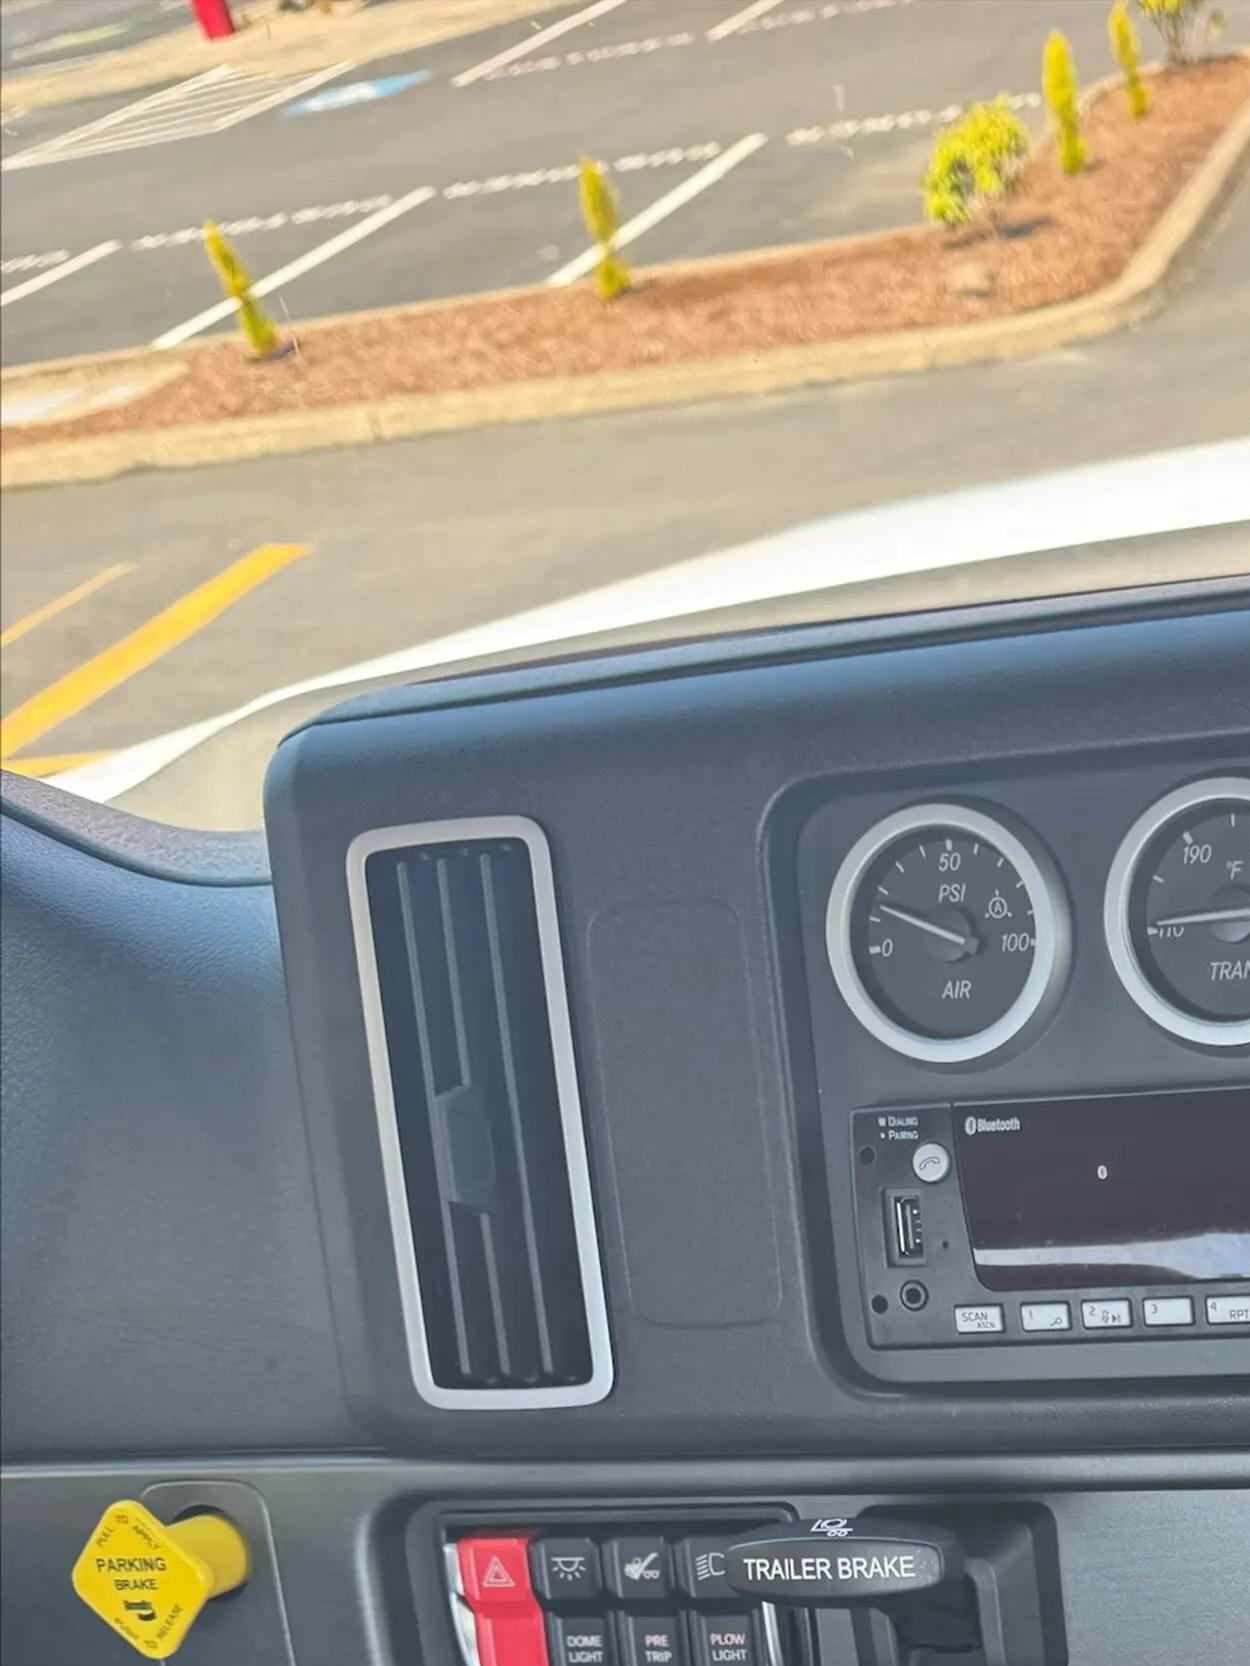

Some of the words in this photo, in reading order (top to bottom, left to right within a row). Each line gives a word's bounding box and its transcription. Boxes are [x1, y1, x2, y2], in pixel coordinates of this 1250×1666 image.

[1183, 845, 1212, 865] 190
[938, 854, 961, 871] 50
[938, 883, 966, 902] PSI
[881, 939, 893, 957] 0
[1001, 933, 1029, 951] 100
[942, 980, 972, 999] AIR
[977, 1117, 1020, 1132] Bluetooth
[961, 1311, 988, 1323] SCAN
[1229, 1308, 1249, 1320] RPT
[95, 1557, 167, 1573] PARKING
[744, 1557, 832, 1581] TRAILER
[838, 1555, 915, 1579] BRAKE
[114, 1578, 158, 1591] BRAKE
[567, 1635, 602, 1648] DOME
[645, 1634, 669, 1648] PRE
[710, 1633, 745, 1646] PLOW
[569, 1650, 603, 1663] LIGHT
[645, 1650, 672, 1663] TRIP
[712, 1649, 748, 1662] LIGHT
